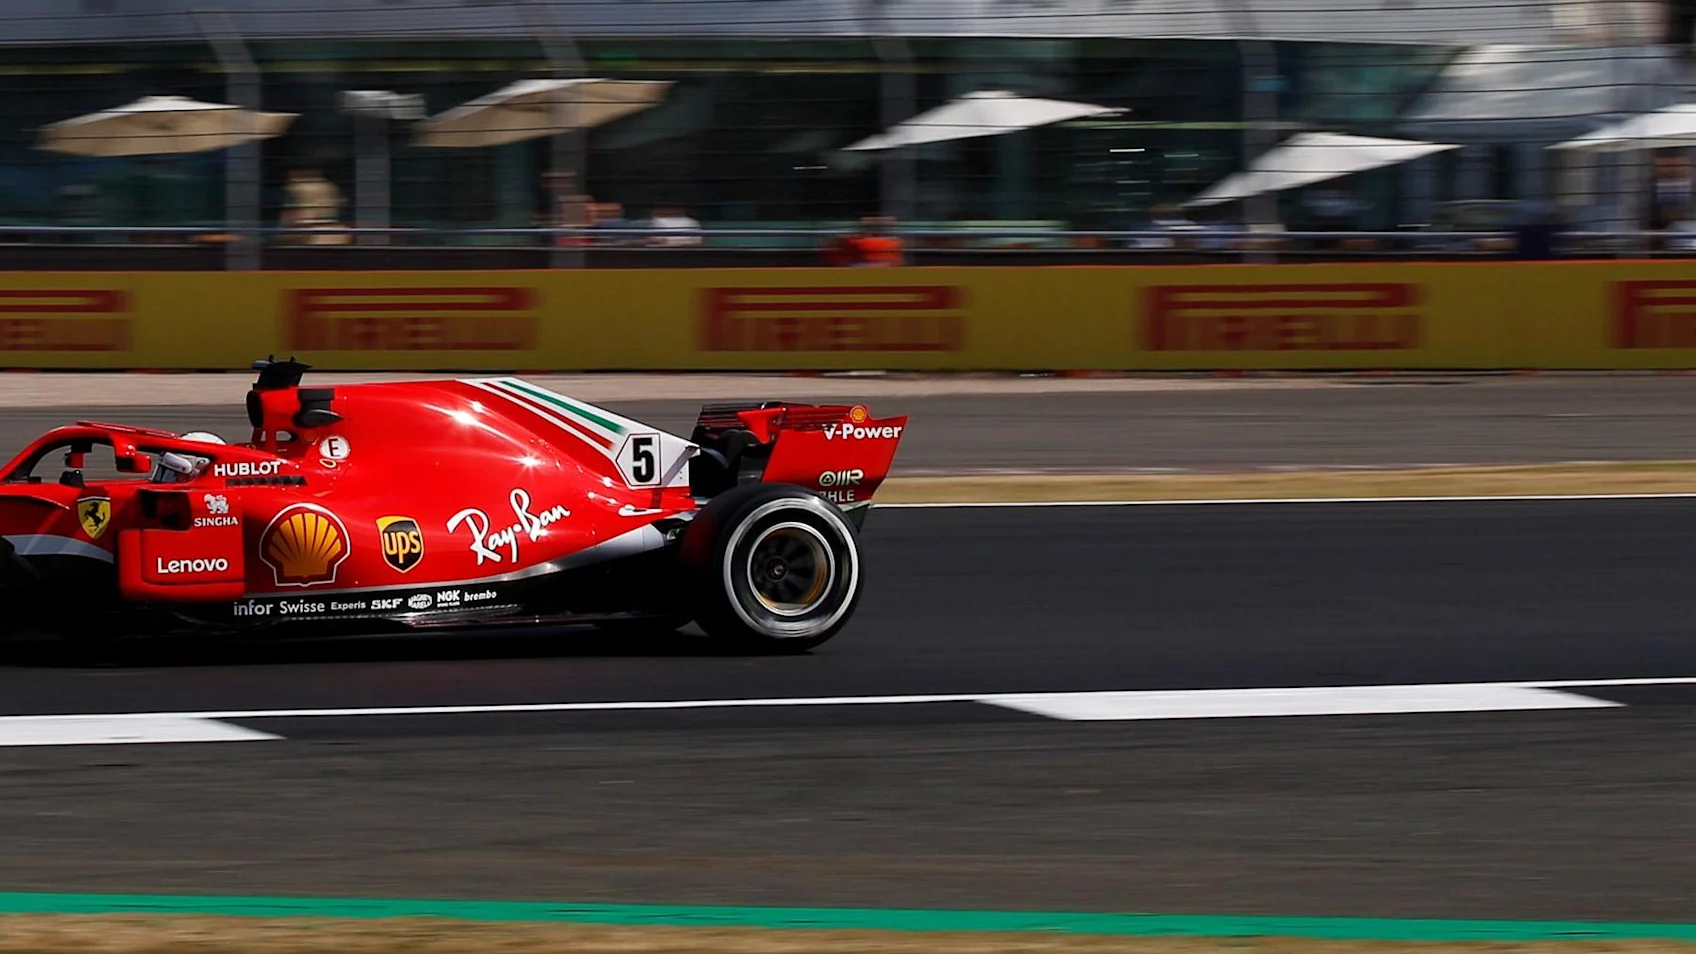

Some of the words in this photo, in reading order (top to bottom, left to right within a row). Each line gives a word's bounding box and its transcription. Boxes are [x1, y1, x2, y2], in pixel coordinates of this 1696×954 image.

[284, 287, 537, 351] PIRELLI
[698, 286, 963, 351] PIRELLI
[1140, 284, 1422, 349] PIRELLI
[822, 423, 902, 440] V-Power
[328, 438, 341, 457] E
[632, 437, 655, 483] 5
[214, 461, 281, 477] HUBLOT
[194, 516, 239, 527] SINGHA
[157, 557, 229, 574] Lenovo
[371, 598, 403, 610] SKF
[437, 590, 460, 602] NGK
[464, 590, 497, 602] brembo
[233, 599, 274, 616] infor
[279, 599, 326, 614] Swisse
[330, 600, 367, 611] Experis
